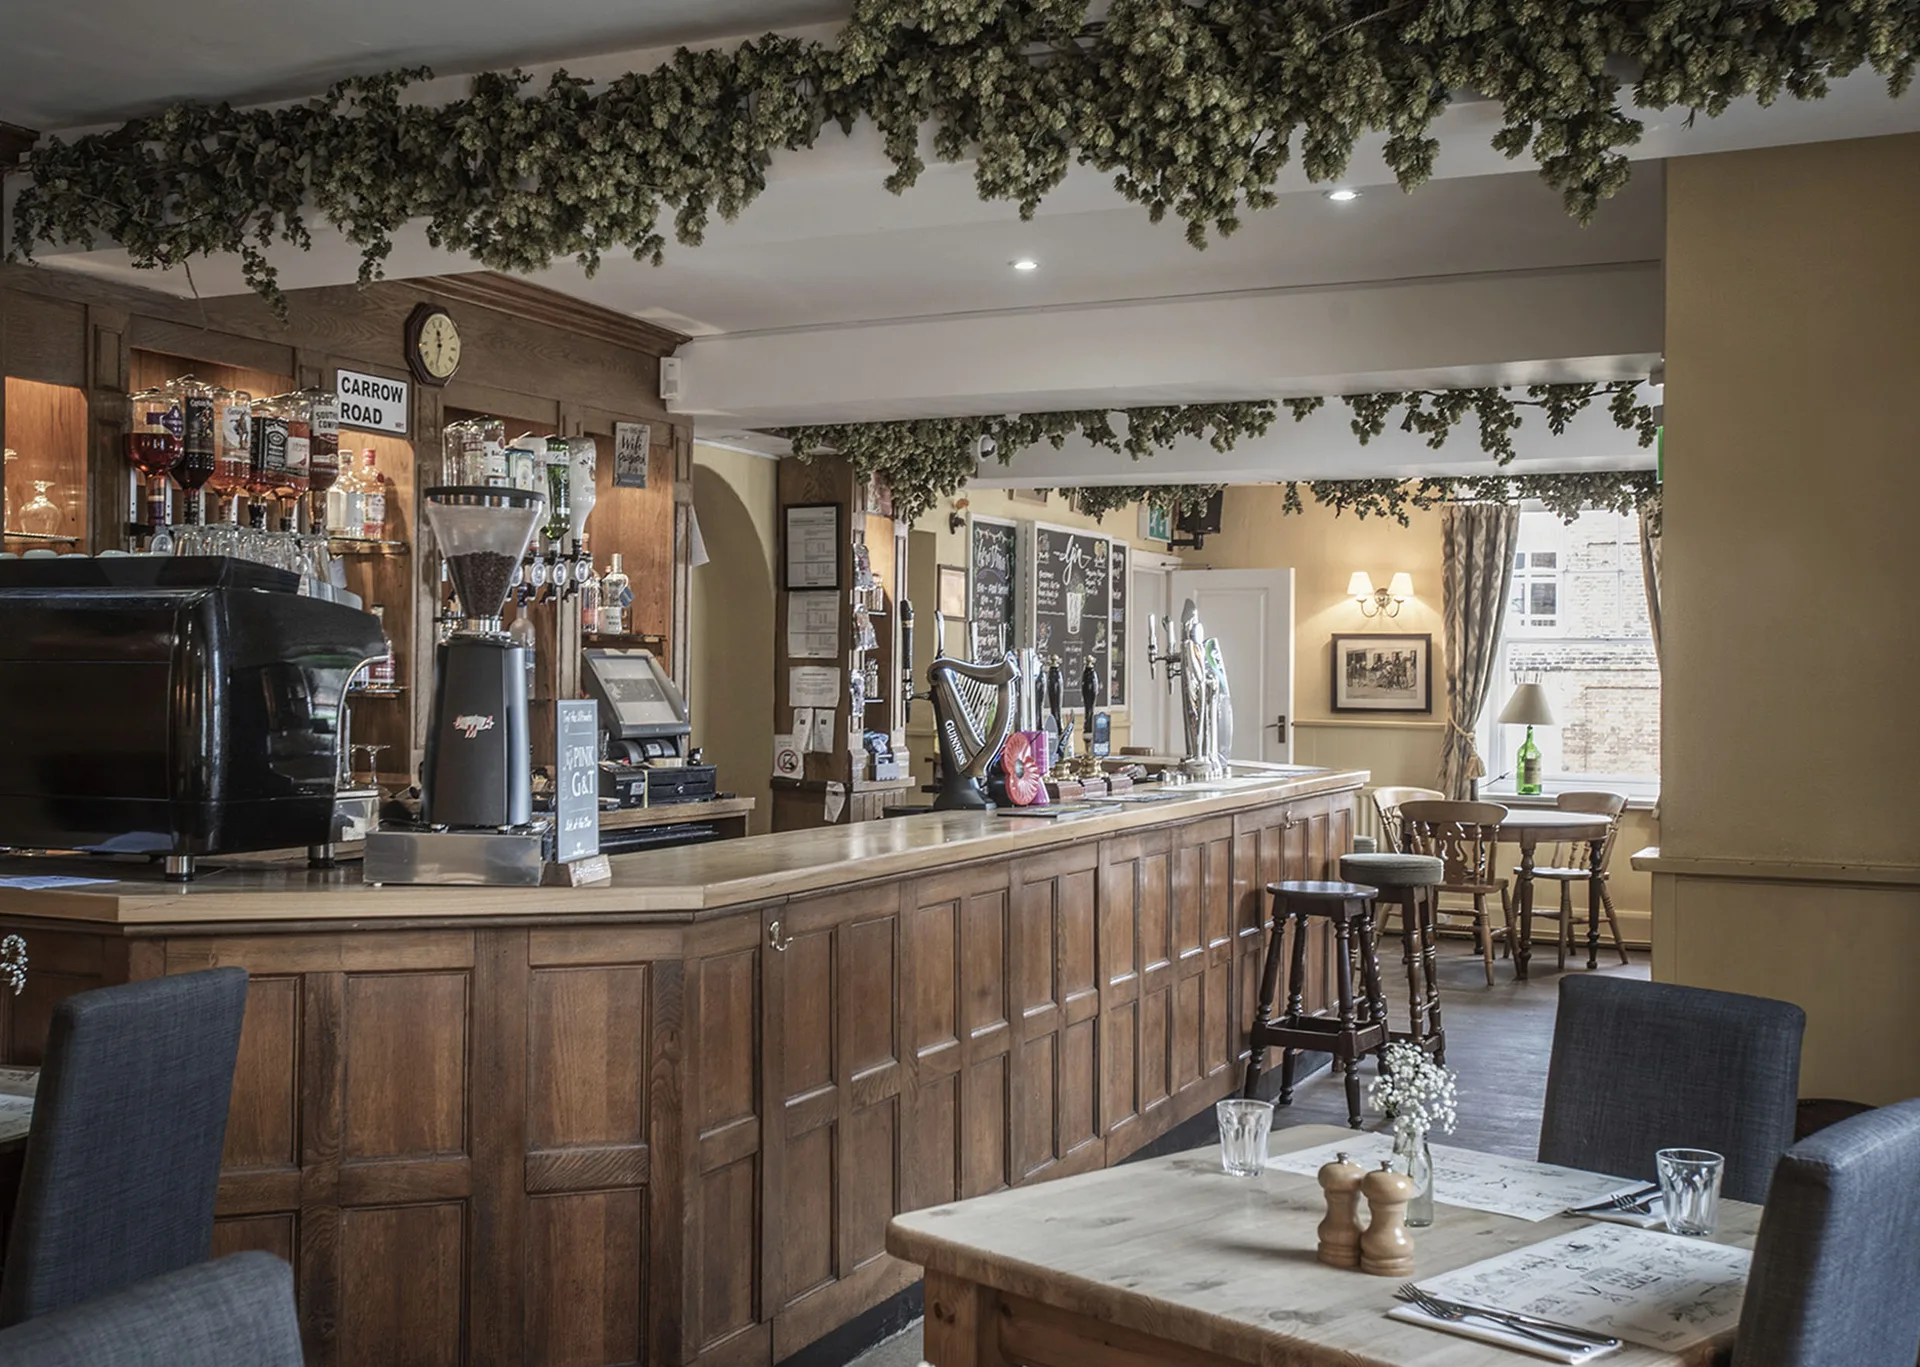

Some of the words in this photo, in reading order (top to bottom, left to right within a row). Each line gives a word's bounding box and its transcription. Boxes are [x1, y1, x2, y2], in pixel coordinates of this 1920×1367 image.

[341, 376, 404, 403] CARROW
[340, 402, 383, 425] ROAD
[945, 719, 968, 766] GUINNESS
[574, 745, 594, 768] PINK
[571, 770, 595, 796] G&T
